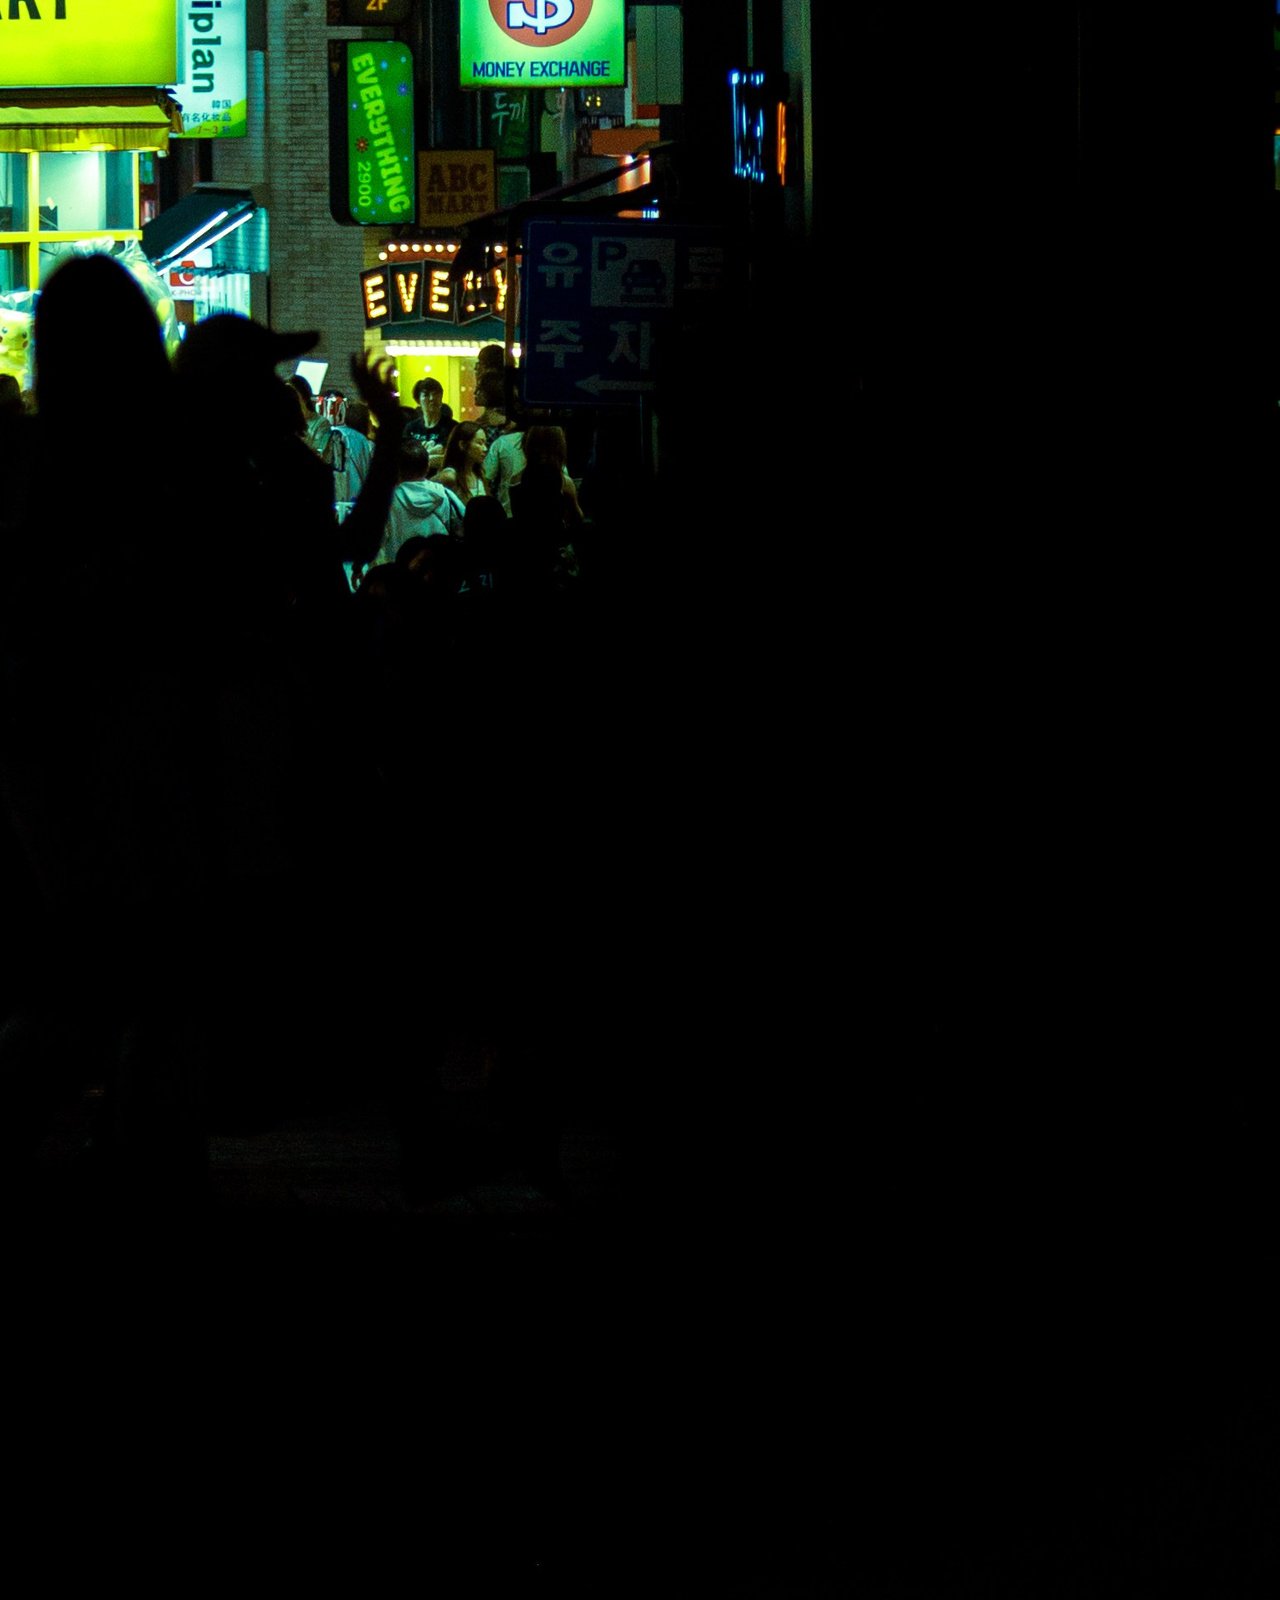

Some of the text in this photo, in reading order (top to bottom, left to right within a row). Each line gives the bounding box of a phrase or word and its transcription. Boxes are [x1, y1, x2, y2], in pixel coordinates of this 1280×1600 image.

[472, 60, 611, 79] MONEY EXCHANGE
[351, 51, 411, 214] EVERYTHING
[357, 161, 371, 207] 2900
[426, 163, 488, 193] ABC
[426, 195, 489, 214] MART
